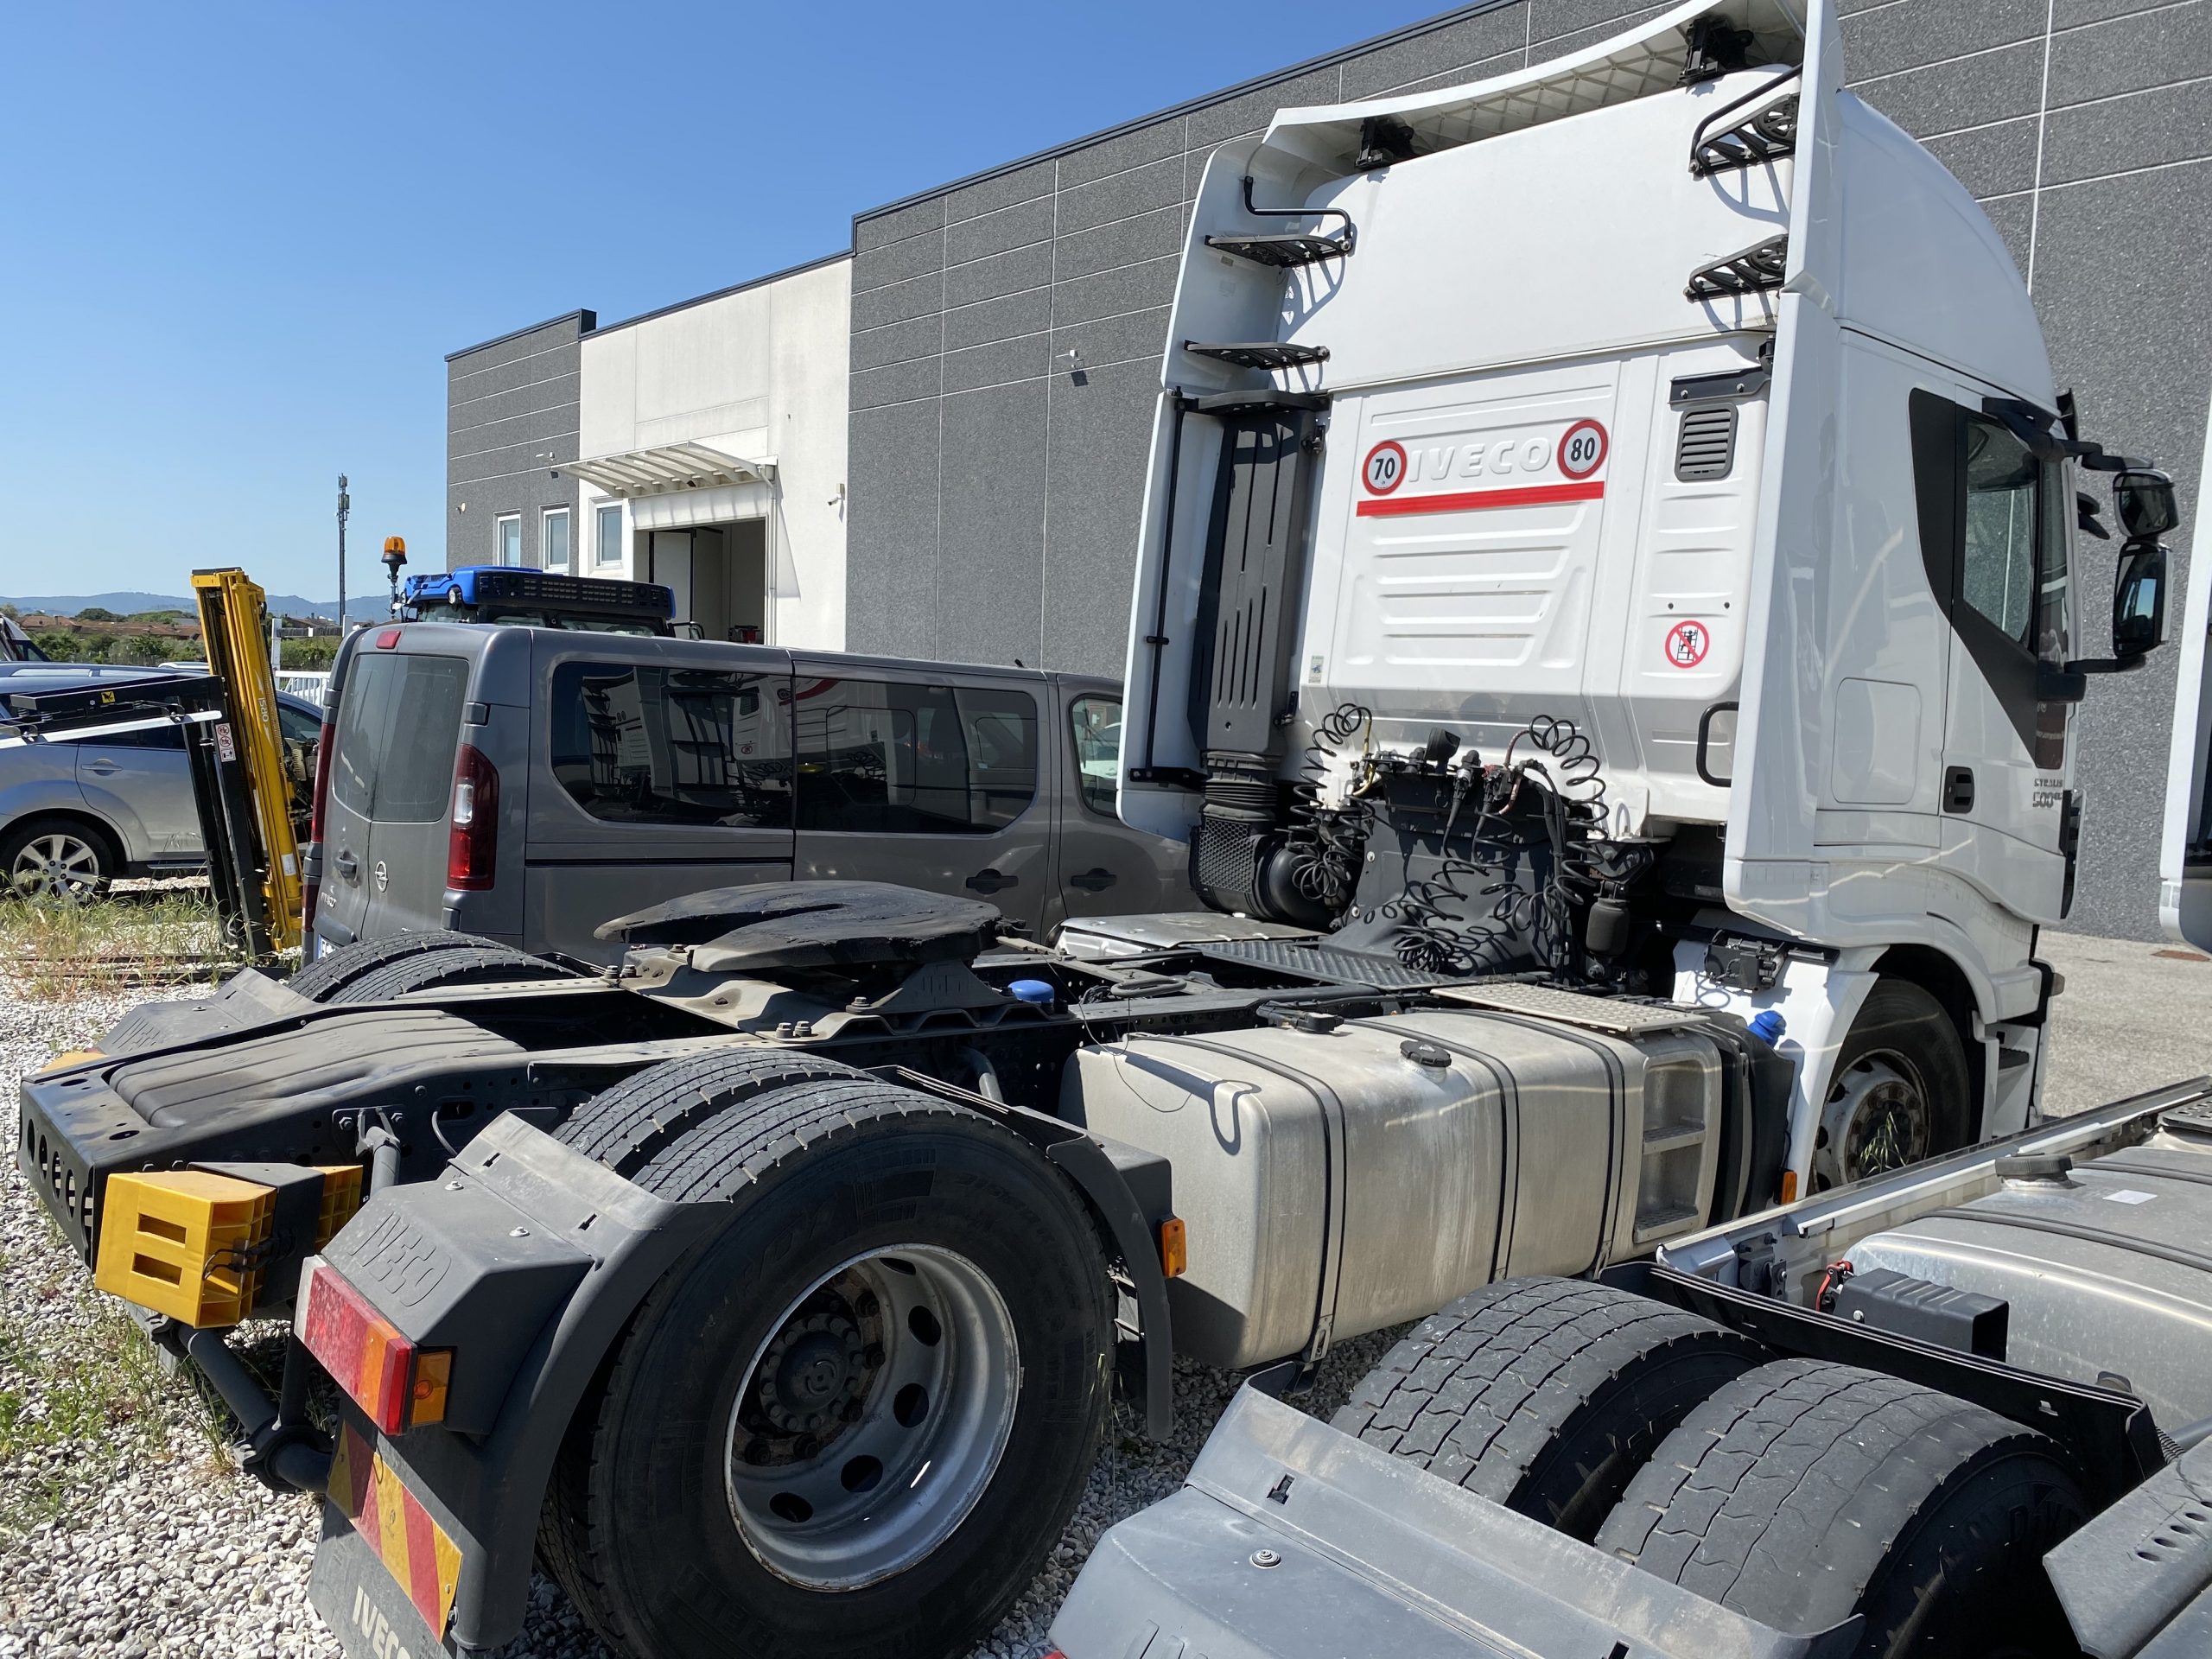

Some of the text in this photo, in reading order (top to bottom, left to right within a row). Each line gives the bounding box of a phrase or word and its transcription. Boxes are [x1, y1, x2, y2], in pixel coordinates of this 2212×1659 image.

[1408, 437, 1552, 482] IVECO
[1571, 436, 1596, 462] 80
[1375, 457, 1395, 480] 70
[258, 698, 269, 722] ORSI
[346, 1211, 452, 1306] IVECO
